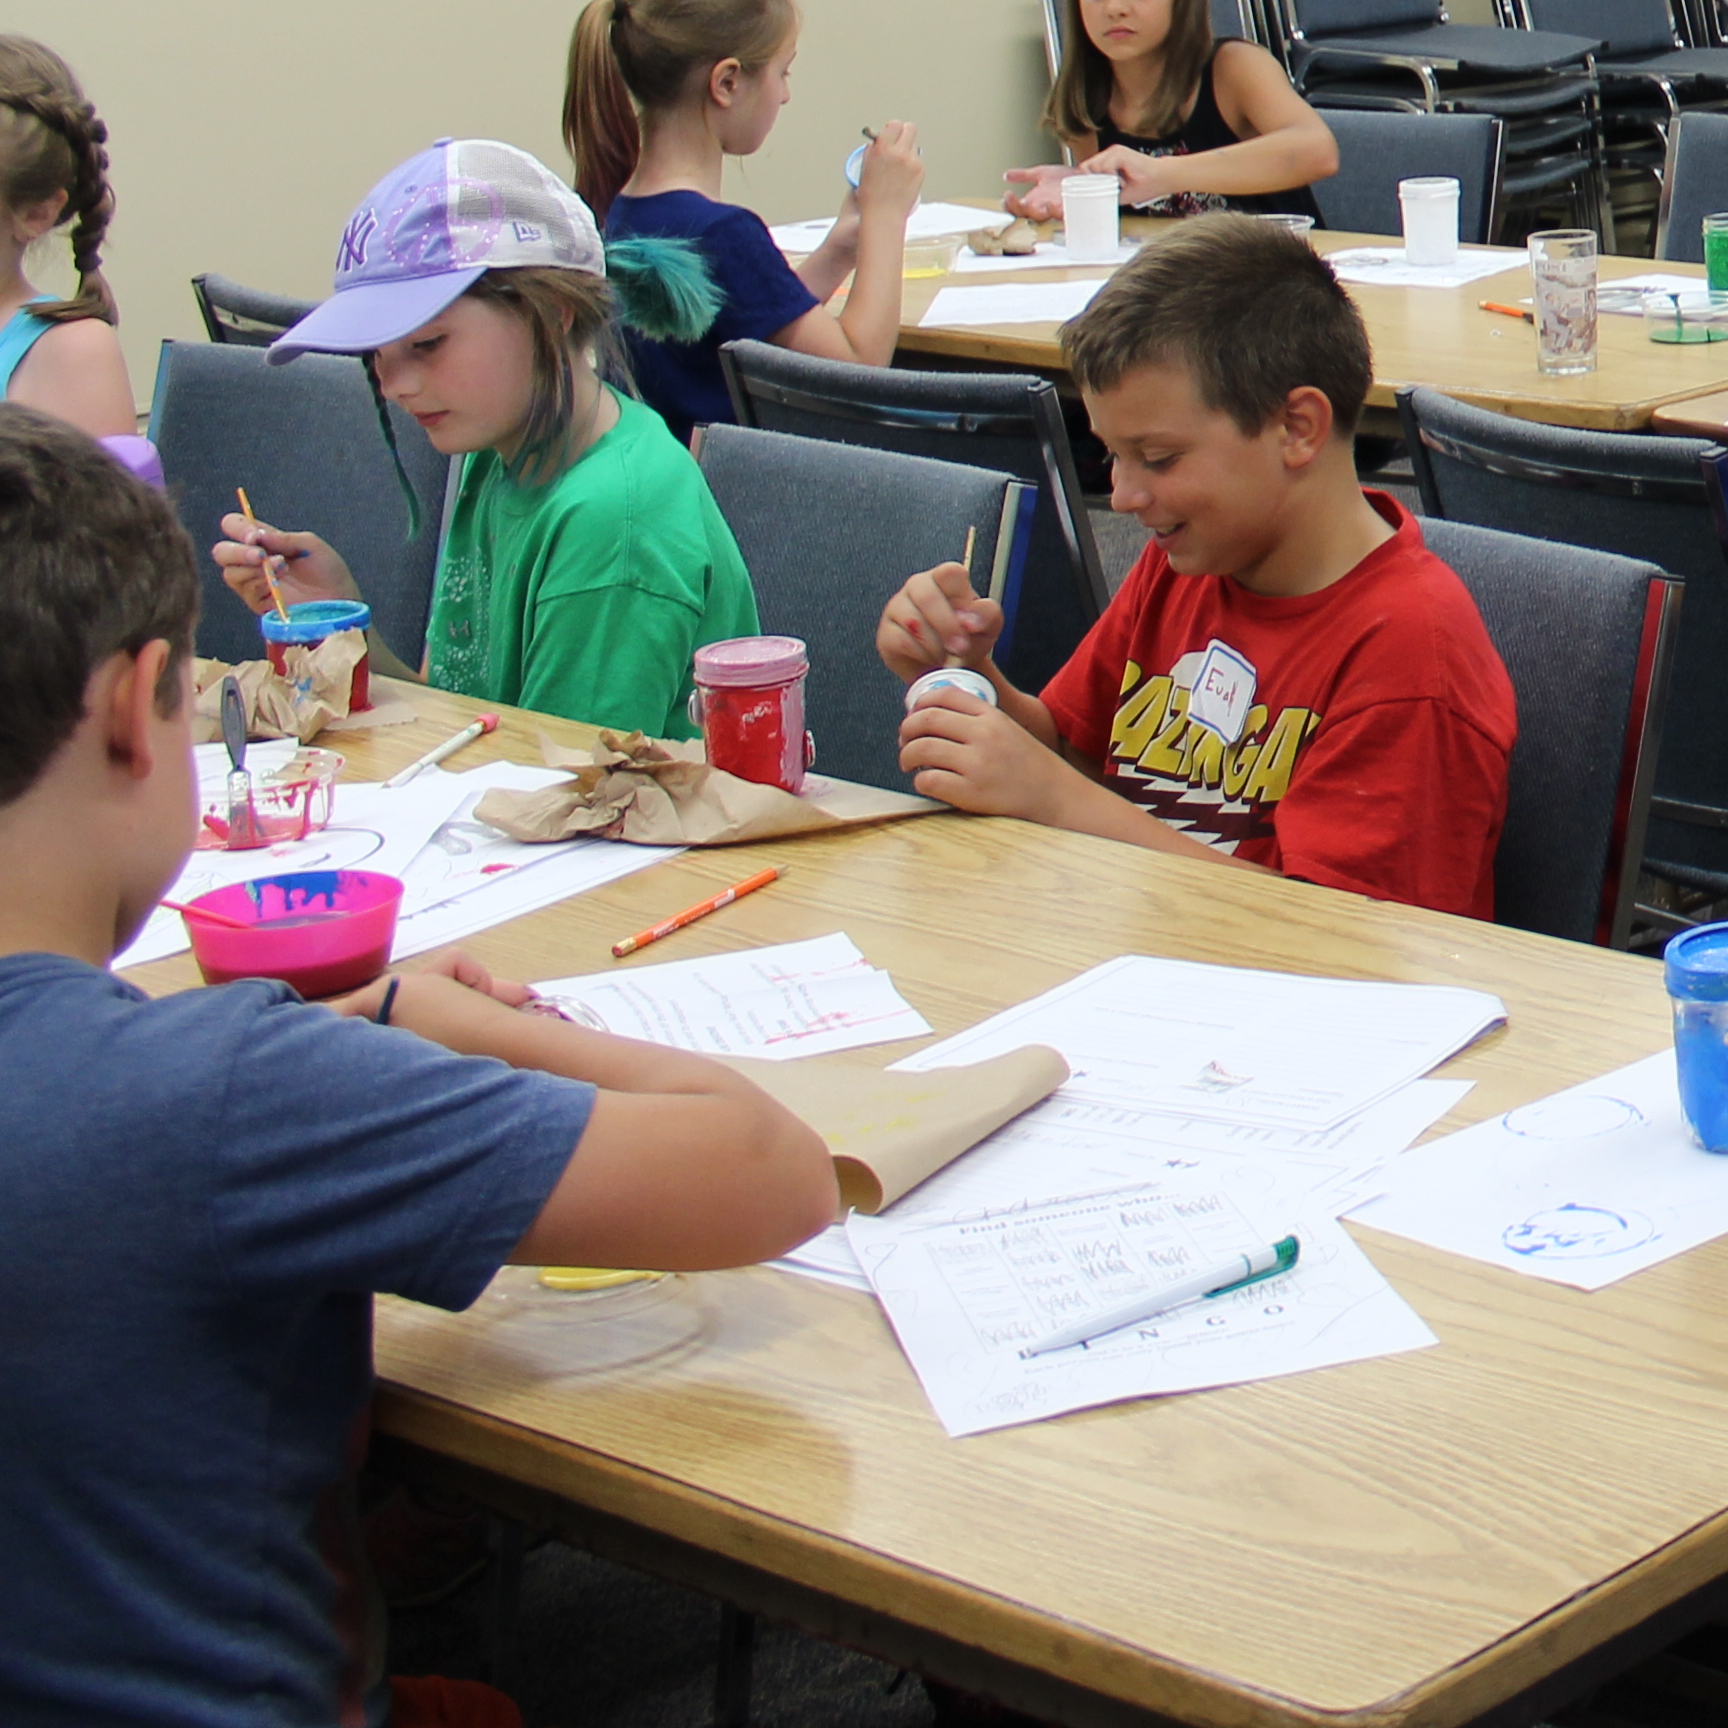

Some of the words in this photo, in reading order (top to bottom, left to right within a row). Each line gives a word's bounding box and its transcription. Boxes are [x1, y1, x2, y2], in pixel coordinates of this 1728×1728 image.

[1014, 1204, 1111, 1227] someone
[1139, 1327, 1160, 1340] N
[1205, 1315, 1227, 1327] G
[1263, 1303, 1285, 1316] O
